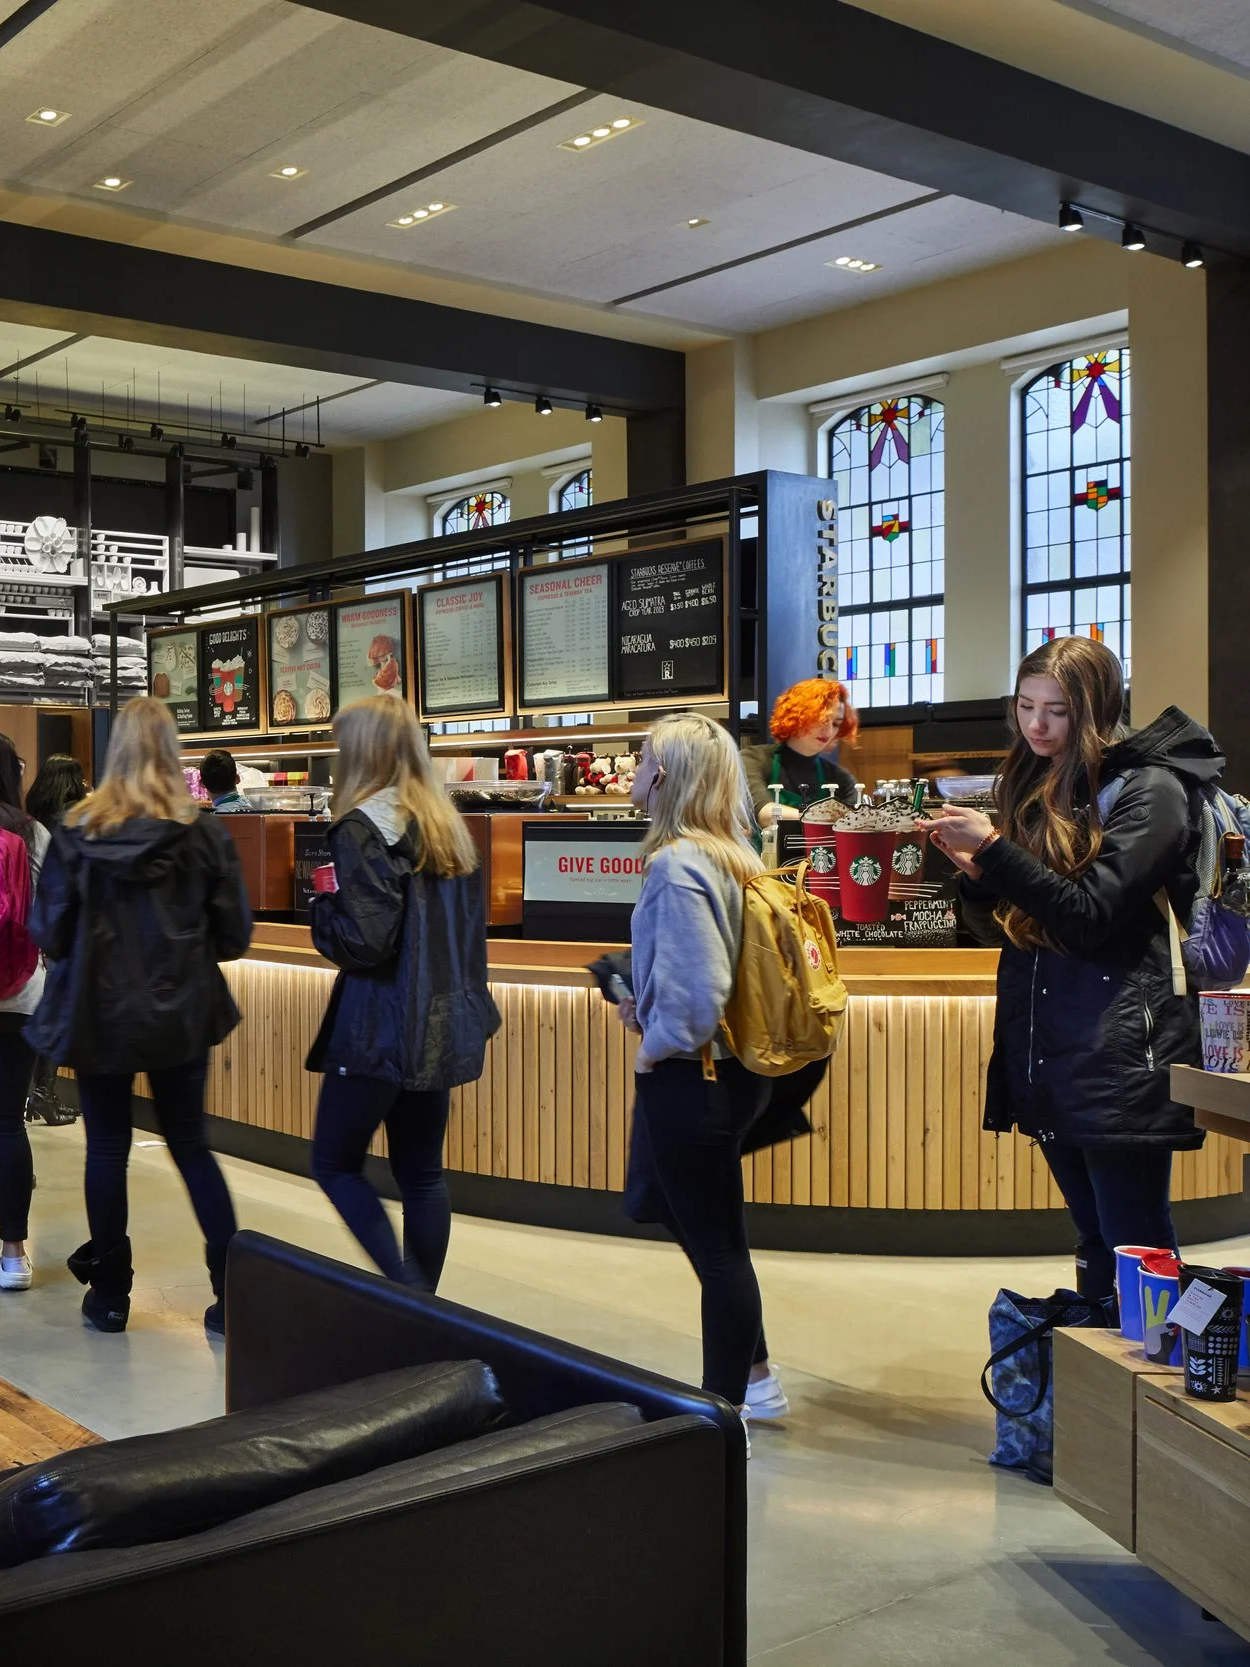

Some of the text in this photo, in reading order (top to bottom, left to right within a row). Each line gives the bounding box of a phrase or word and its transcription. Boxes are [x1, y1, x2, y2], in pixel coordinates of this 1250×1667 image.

[630, 565, 656, 579] STARBUCKS
[683, 558, 705, 570] COFFEES
[529, 574, 602, 595] SEASONAL CHEER
[817, 500, 838, 680] STARBUC
[436, 592, 483, 608] CLASSIC JOY
[621, 599, 637, 612] AGED
[639, 596, 665, 608] SUMATRA
[342, 607, 397, 623] WARM GOODNESS
[209, 629, 247, 645] GOOD DELIGHTS
[558, 856, 645, 875] GIVE GOOD
[905, 899, 956, 910] PEPPERMINT
[912, 911, 943, 921] MOCHA
[856, 923, 885, 931] TOASTED
[904, 920, 957, 931] FRAPPUCCINO
[836, 930, 860, 938] WHITE
[1225, 1005, 1244, 1016] IS
